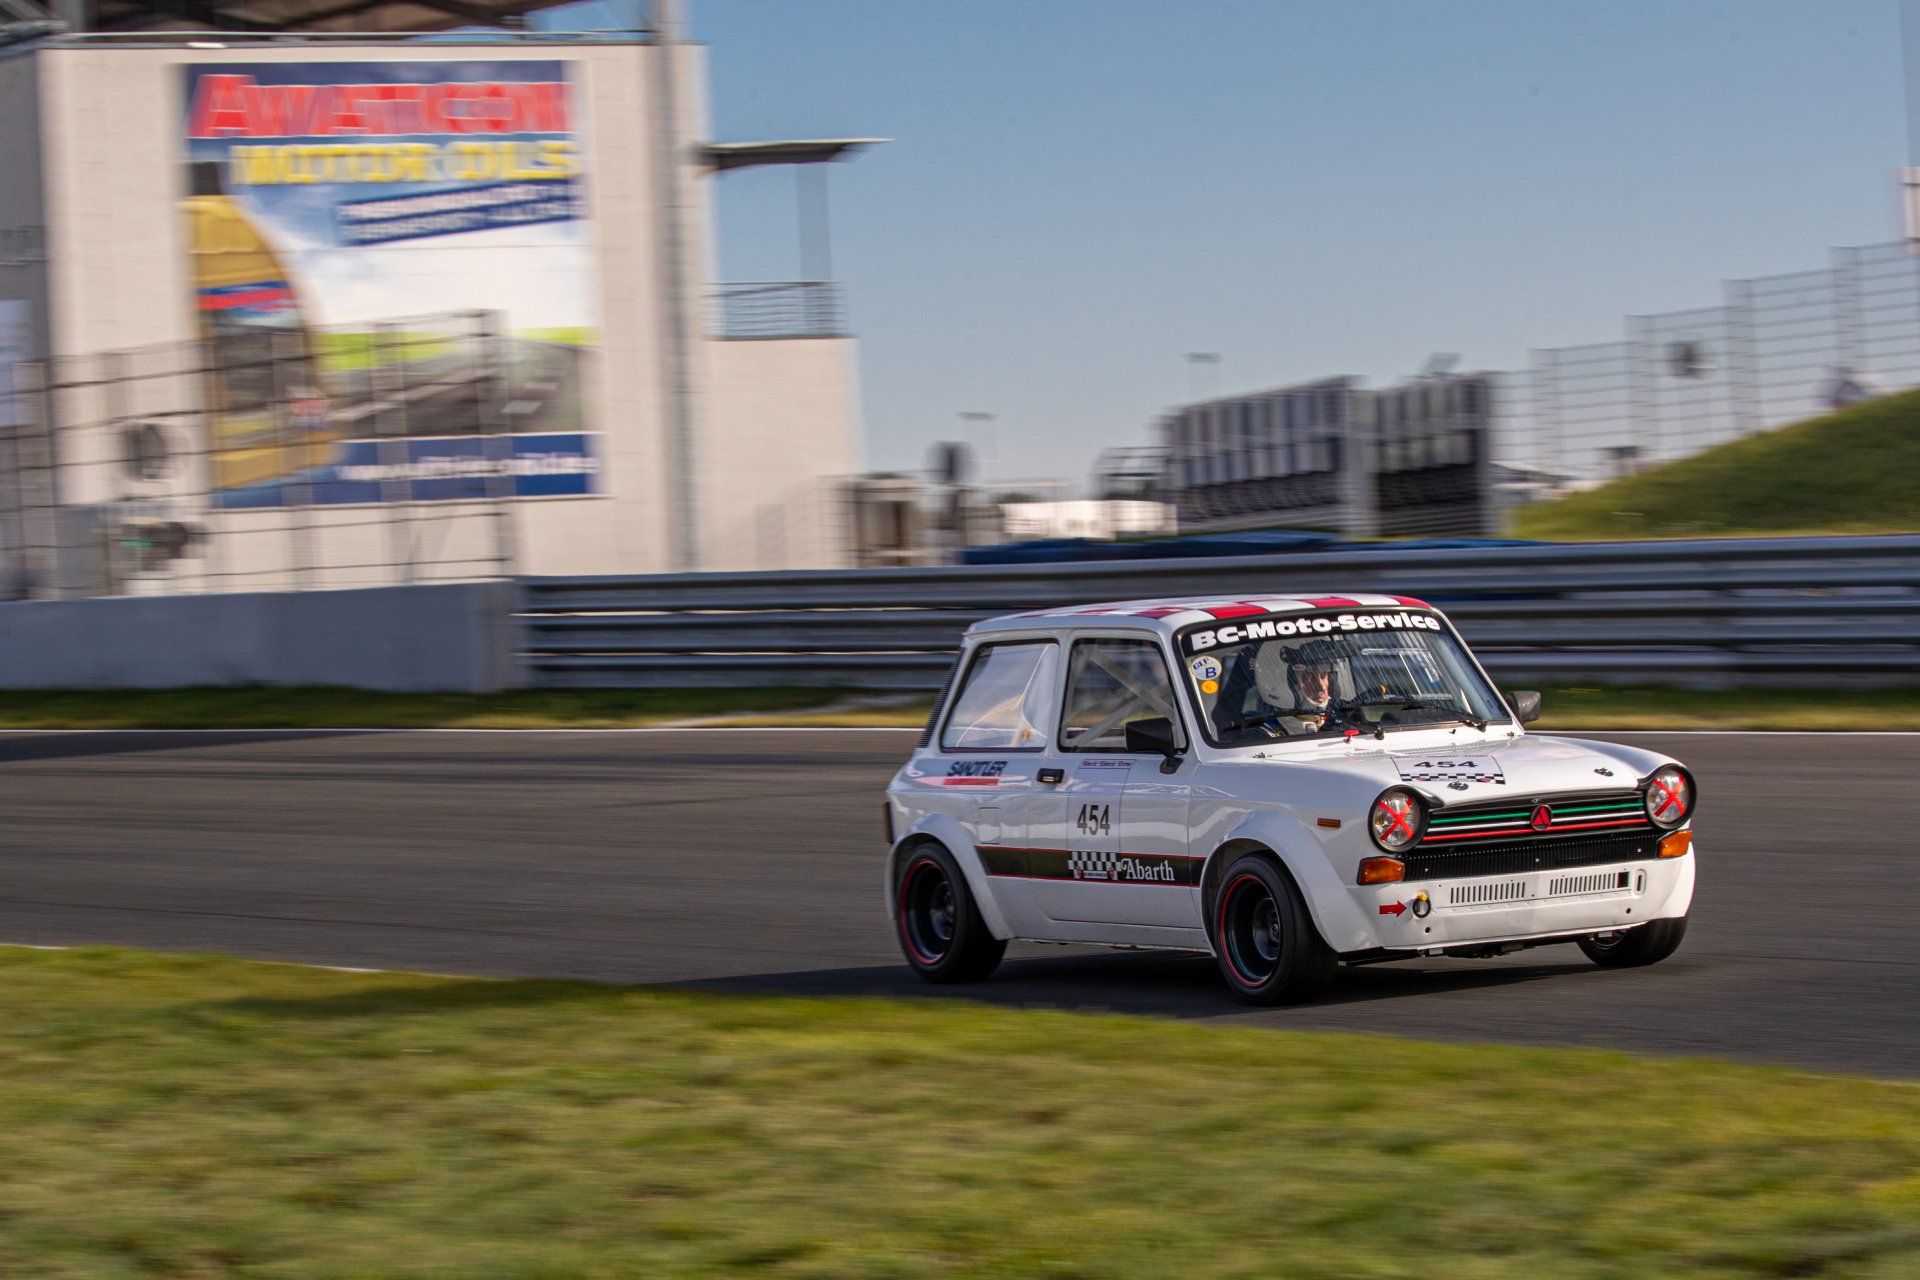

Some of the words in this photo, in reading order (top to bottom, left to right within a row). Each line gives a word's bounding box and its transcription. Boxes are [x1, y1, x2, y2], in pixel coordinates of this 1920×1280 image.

[1191, 612, 1441, 651] BC-Moto-Service
[1205, 666, 1217, 678] B
[1414, 760, 1479, 768] 454
[1077, 803, 1111, 836] 454
[1121, 858, 1175, 881] Abarth
